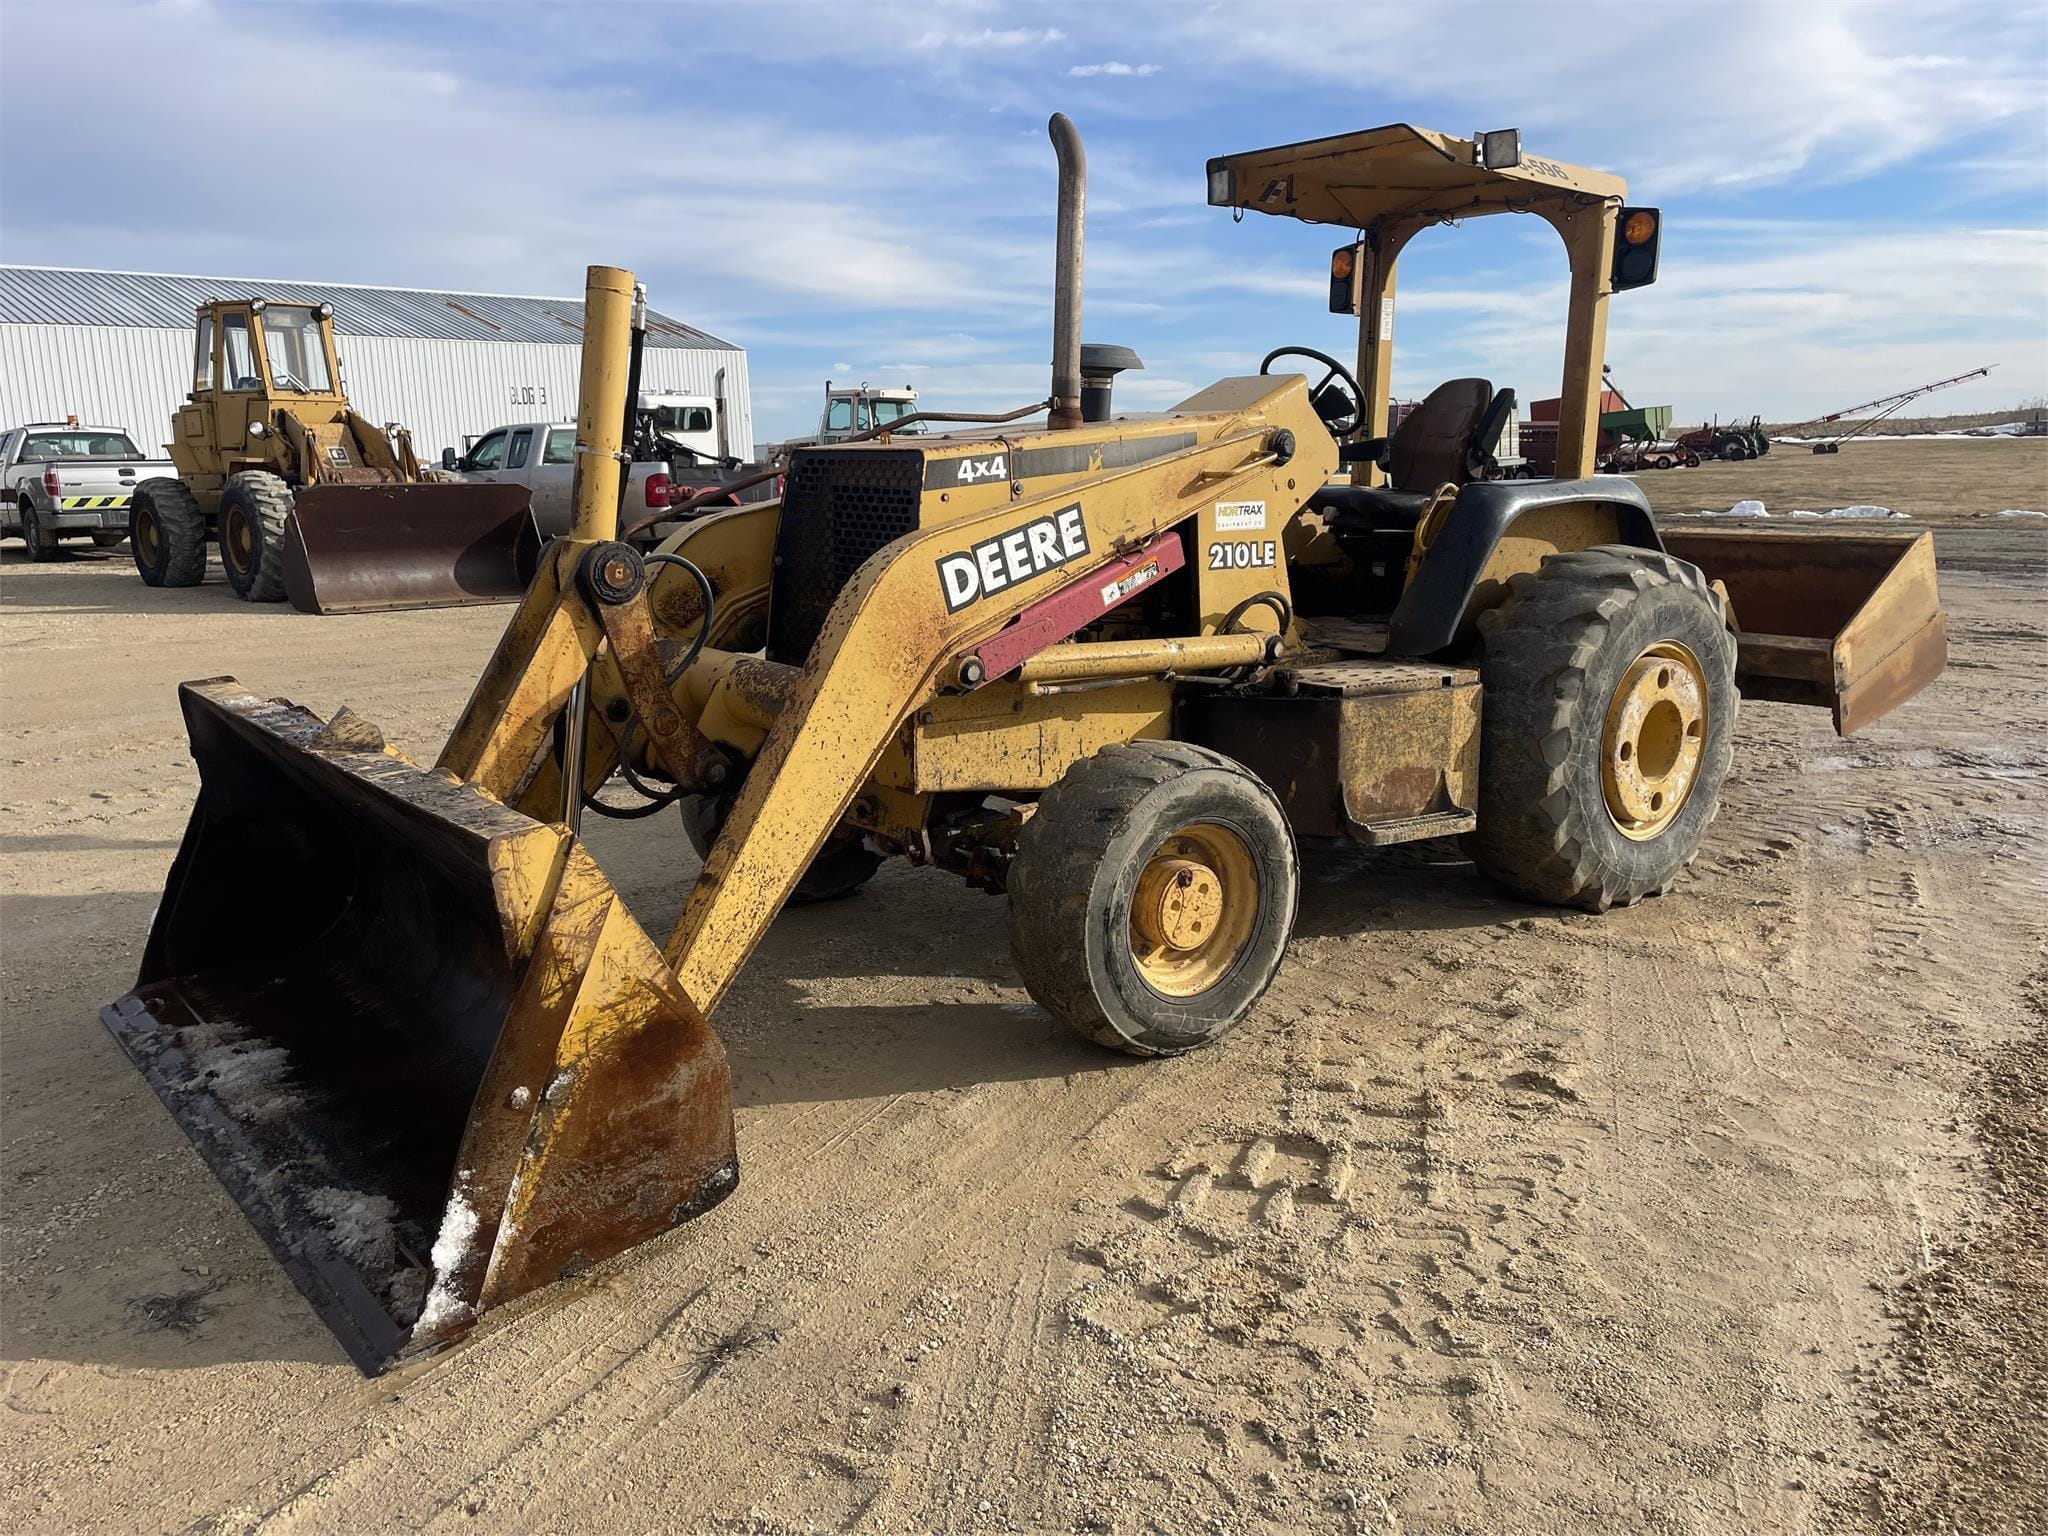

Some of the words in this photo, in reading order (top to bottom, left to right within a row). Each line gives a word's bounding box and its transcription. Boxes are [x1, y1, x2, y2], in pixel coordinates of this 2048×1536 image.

[957, 456, 1007, 482] 4x4
[1217, 504, 1263, 516] NORTRAX
[938, 505, 1088, 611] DEERE
[1208, 541, 1276, 570] 210LE
